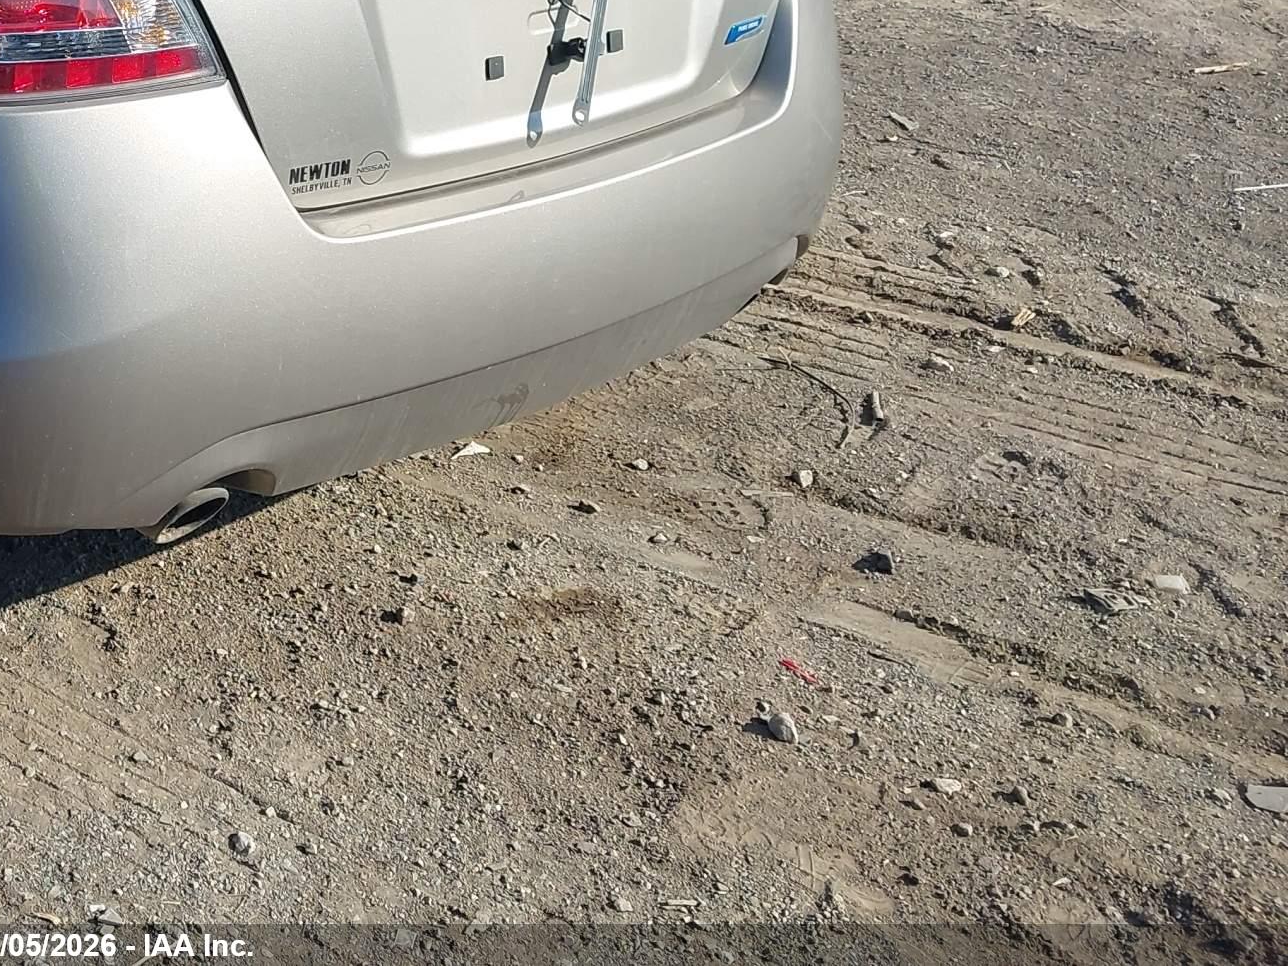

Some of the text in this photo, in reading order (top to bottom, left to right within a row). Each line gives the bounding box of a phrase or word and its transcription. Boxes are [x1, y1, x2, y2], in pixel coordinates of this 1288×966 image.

[289, 159, 351, 185] NEWTON
[356, 162, 391, 174] NISSAN
[292, 177, 352, 195] SHELBYVILLE, TN
